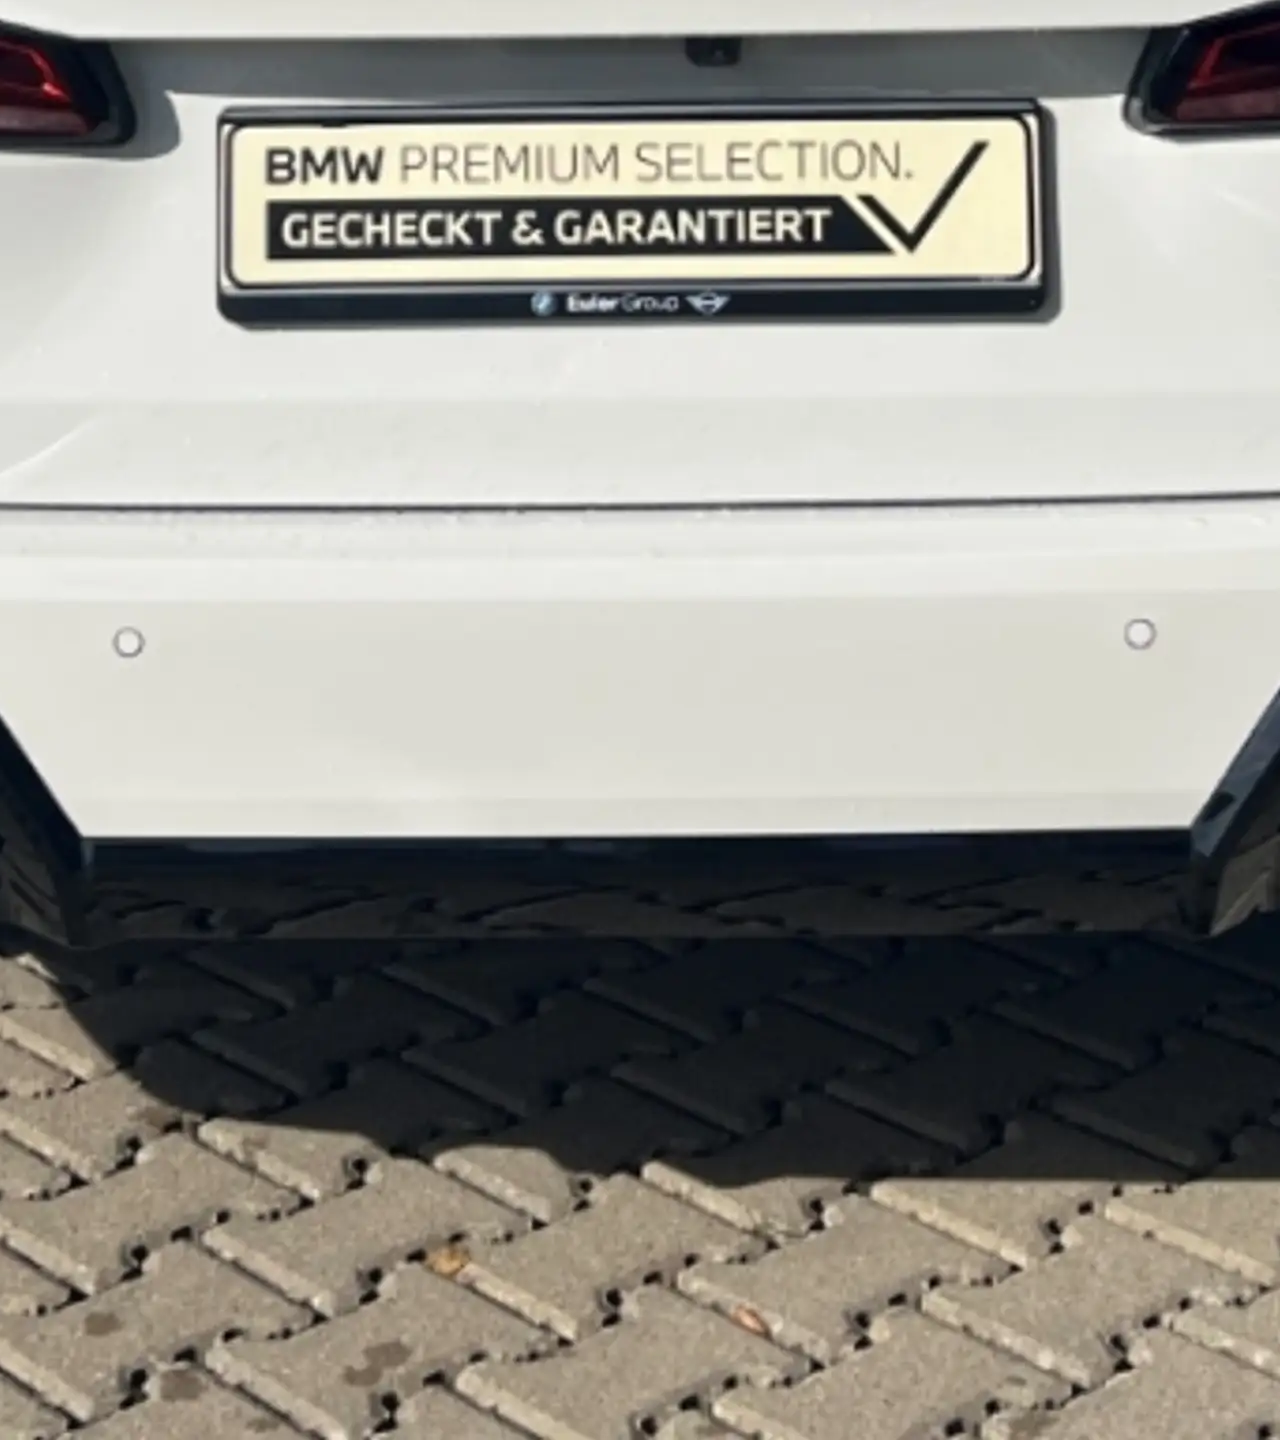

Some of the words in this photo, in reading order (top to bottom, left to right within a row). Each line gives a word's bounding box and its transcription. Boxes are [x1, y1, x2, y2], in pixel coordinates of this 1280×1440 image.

[265, 145, 384, 186] BMW
[399, 142, 620, 184] PREMIUM
[633, 139, 914, 183] SELECTION.
[281, 209, 503, 249] GECHECKT
[510, 210, 546, 247] &
[552, 206, 834, 247] GARANTIERT
